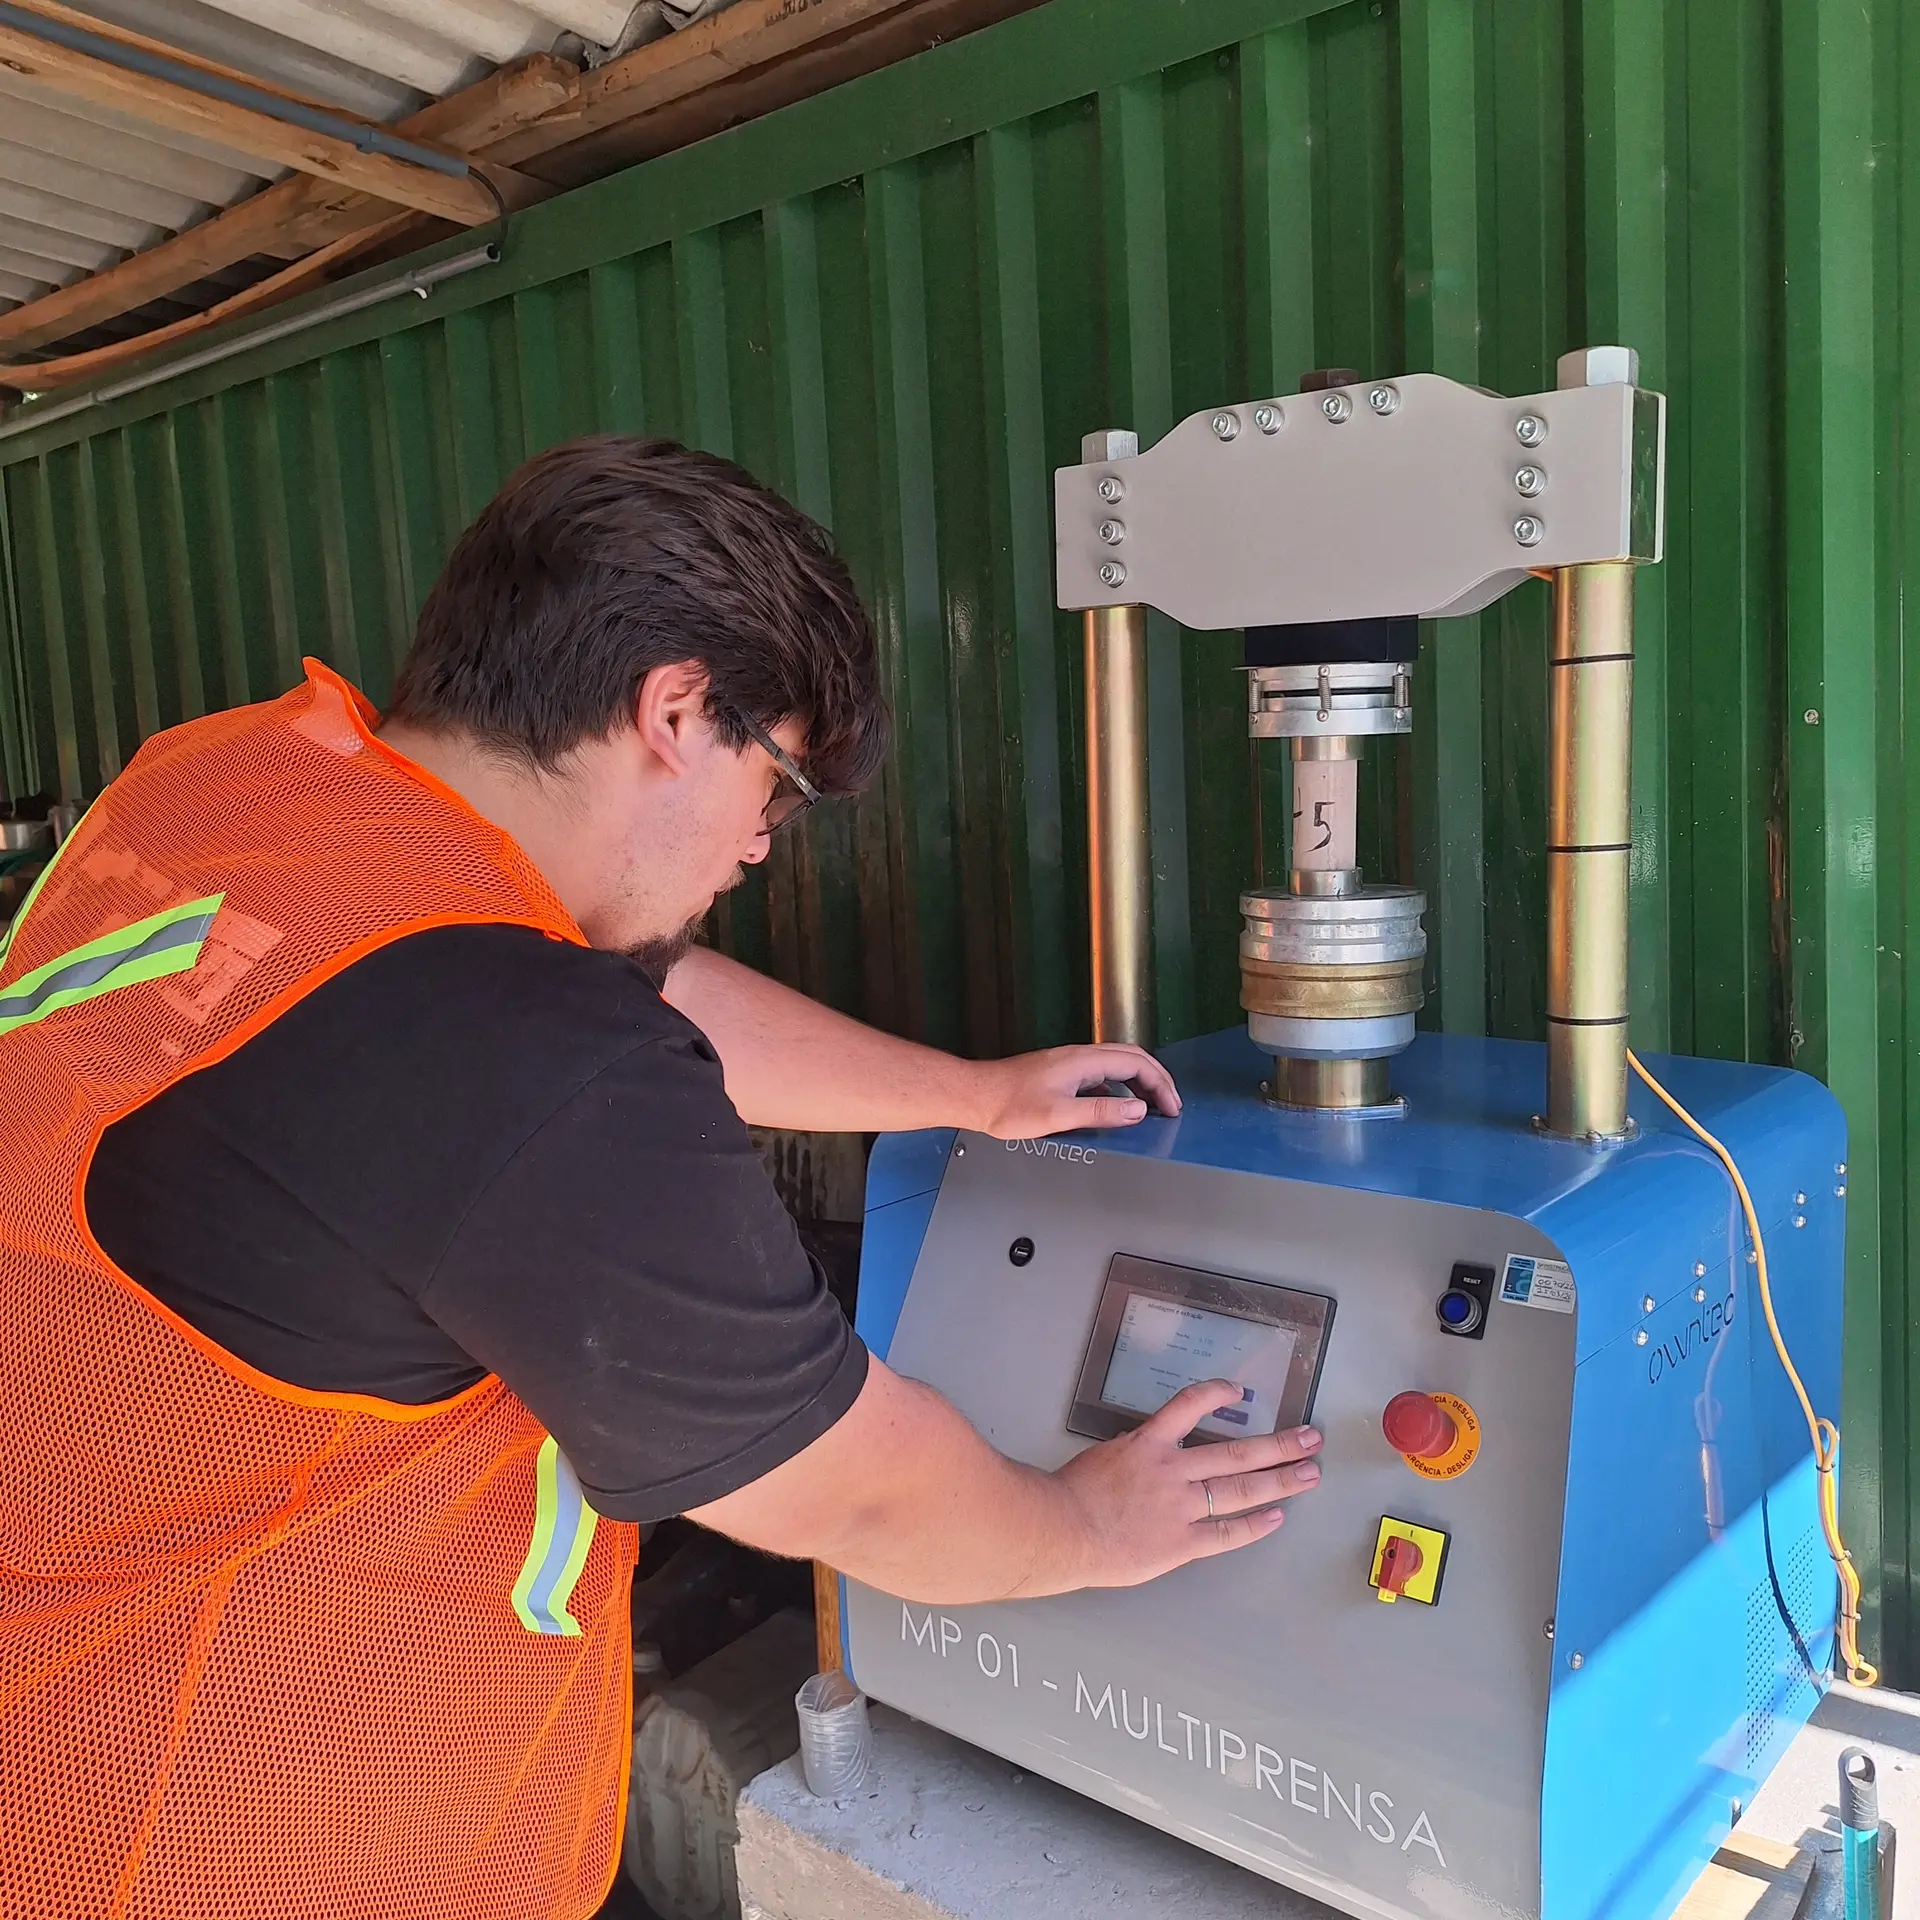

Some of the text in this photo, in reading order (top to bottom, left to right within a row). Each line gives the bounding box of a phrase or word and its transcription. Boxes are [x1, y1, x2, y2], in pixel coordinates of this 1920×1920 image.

[1463, 1277, 1482, 1285] RESET
[1452, 1400, 1476, 1431] DESLIGA
[1446, 1448, 1475, 1475] DESLIGA
[901, 1603, 962, 1658] MP
[976, 1632, 1020, 1688] 01
[1074, 1670, 1448, 1868] MULTIPRENSA
